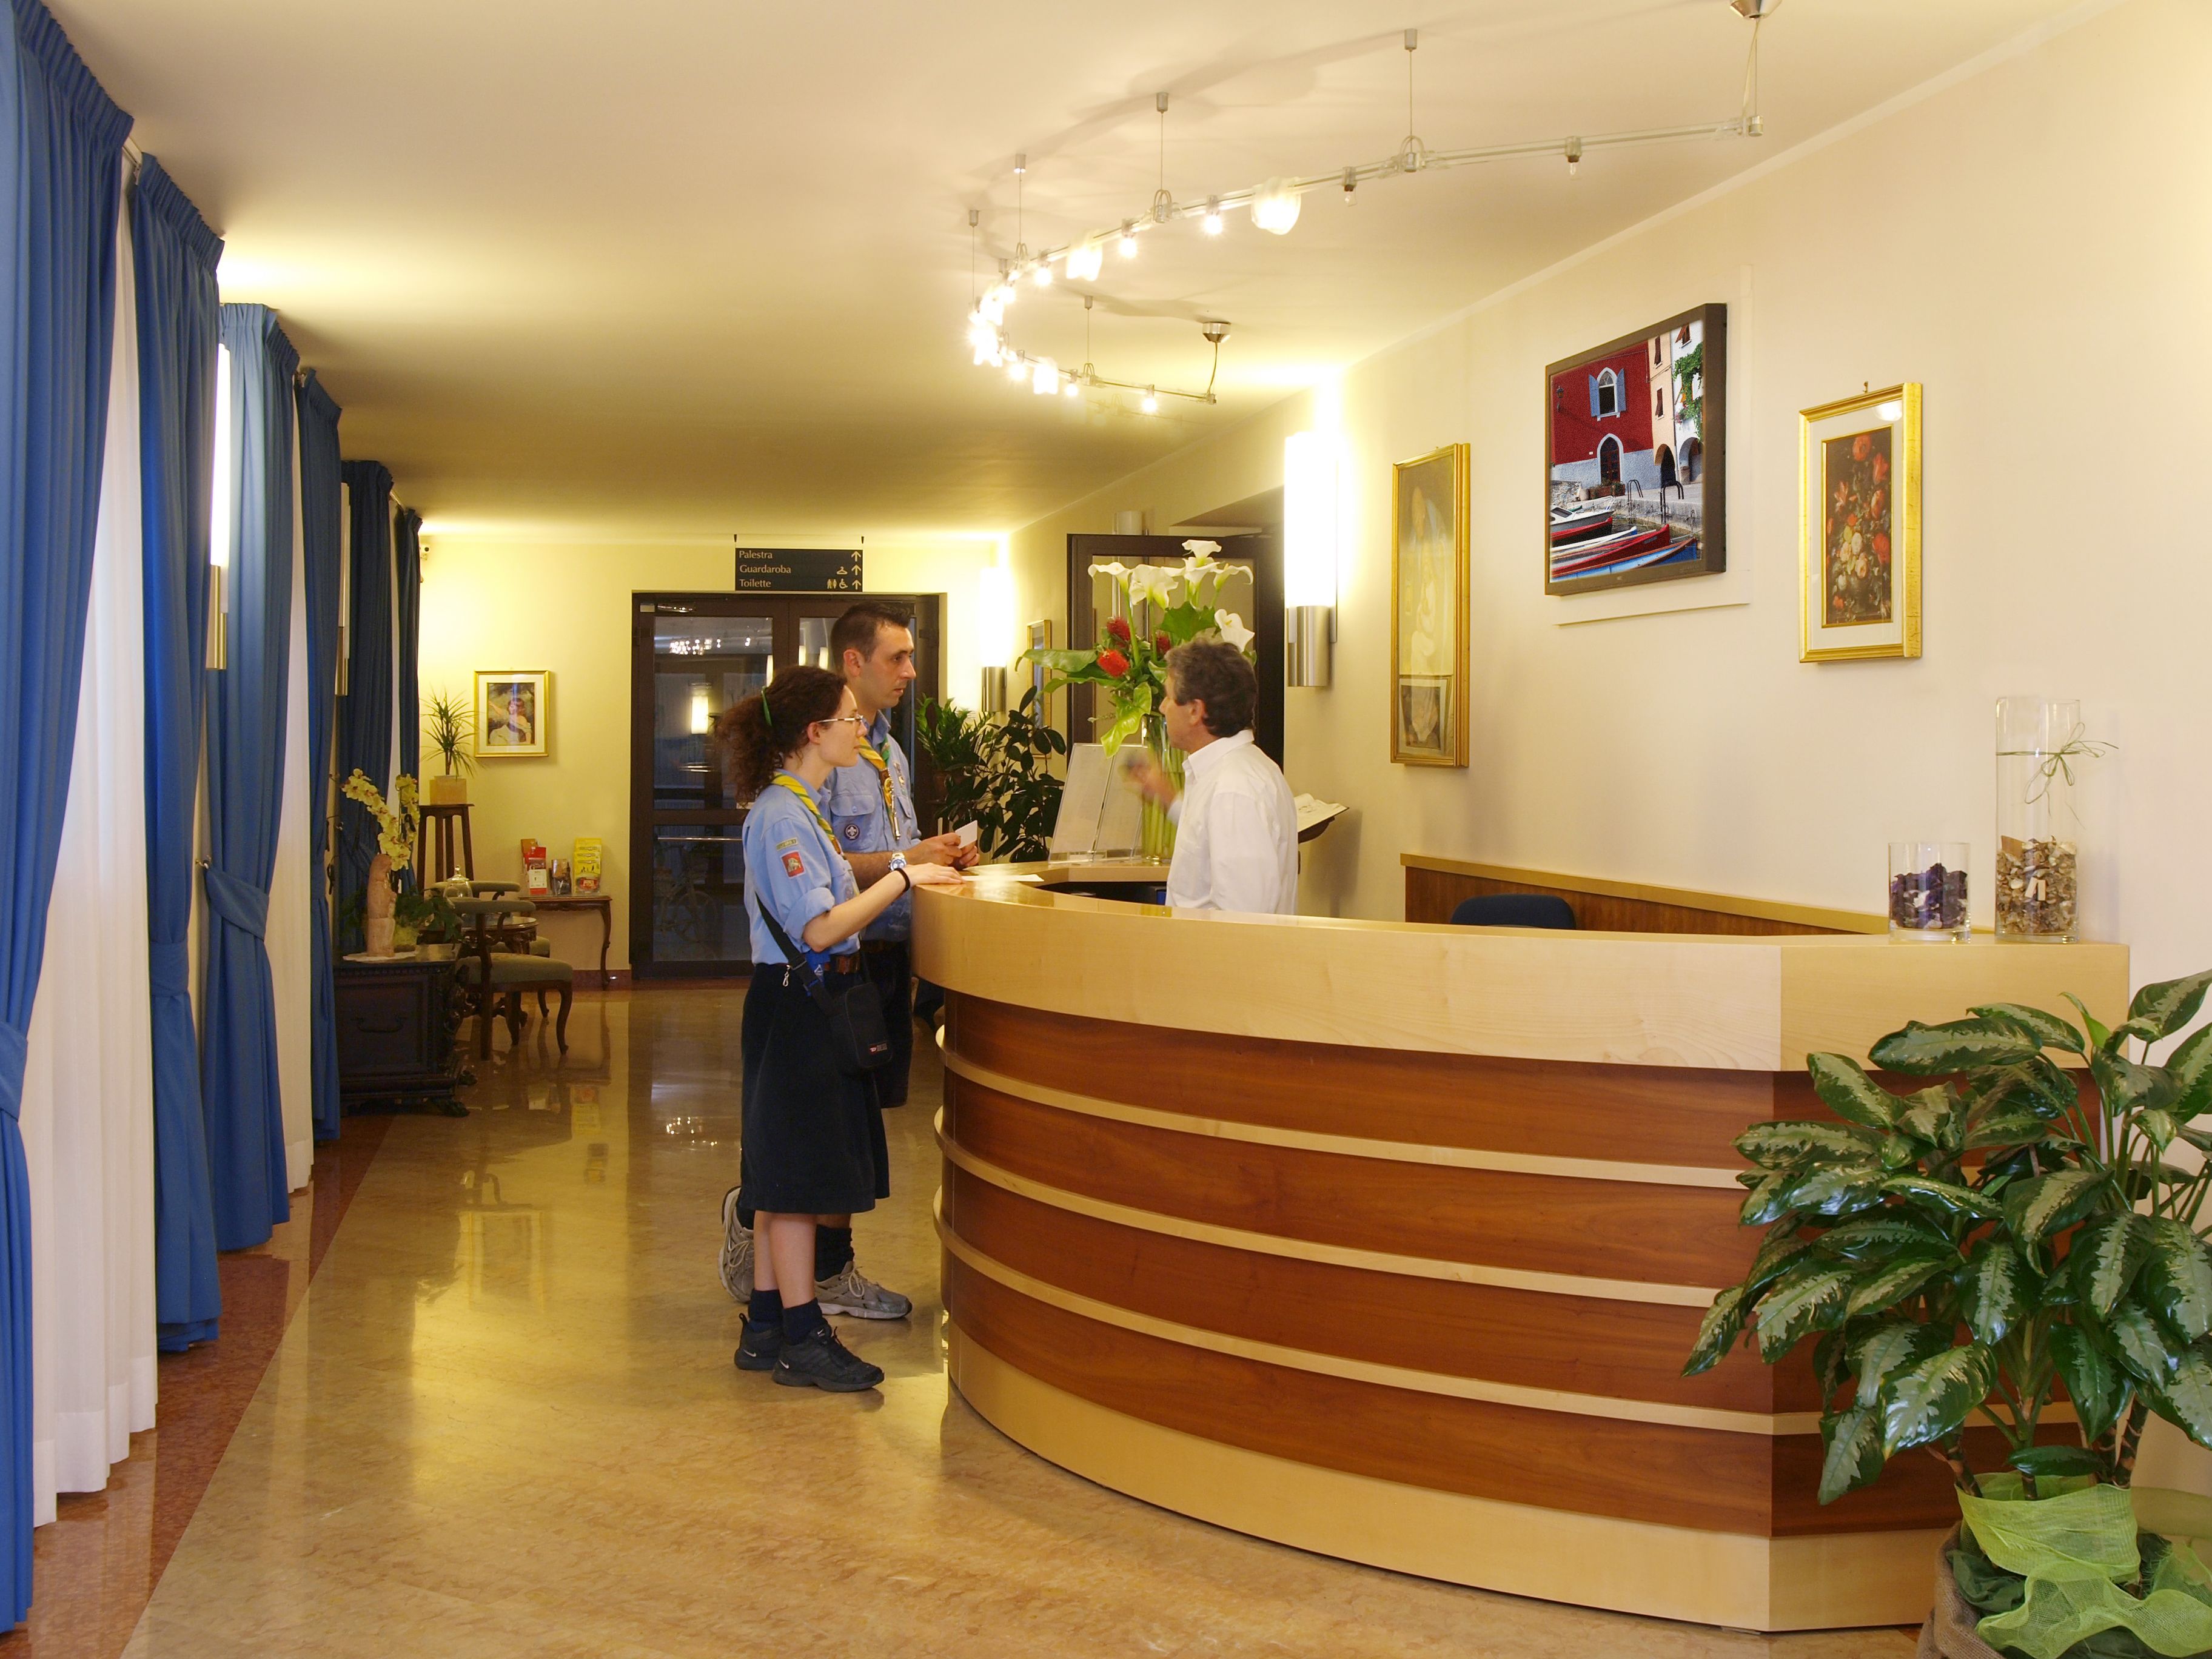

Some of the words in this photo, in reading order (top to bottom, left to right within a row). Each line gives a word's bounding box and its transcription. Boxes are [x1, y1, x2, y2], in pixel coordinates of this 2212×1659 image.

[739, 550, 773, 559] Palestra
[739, 565, 791, 574] Guardaroba
[739, 578, 771, 588] Toilette
